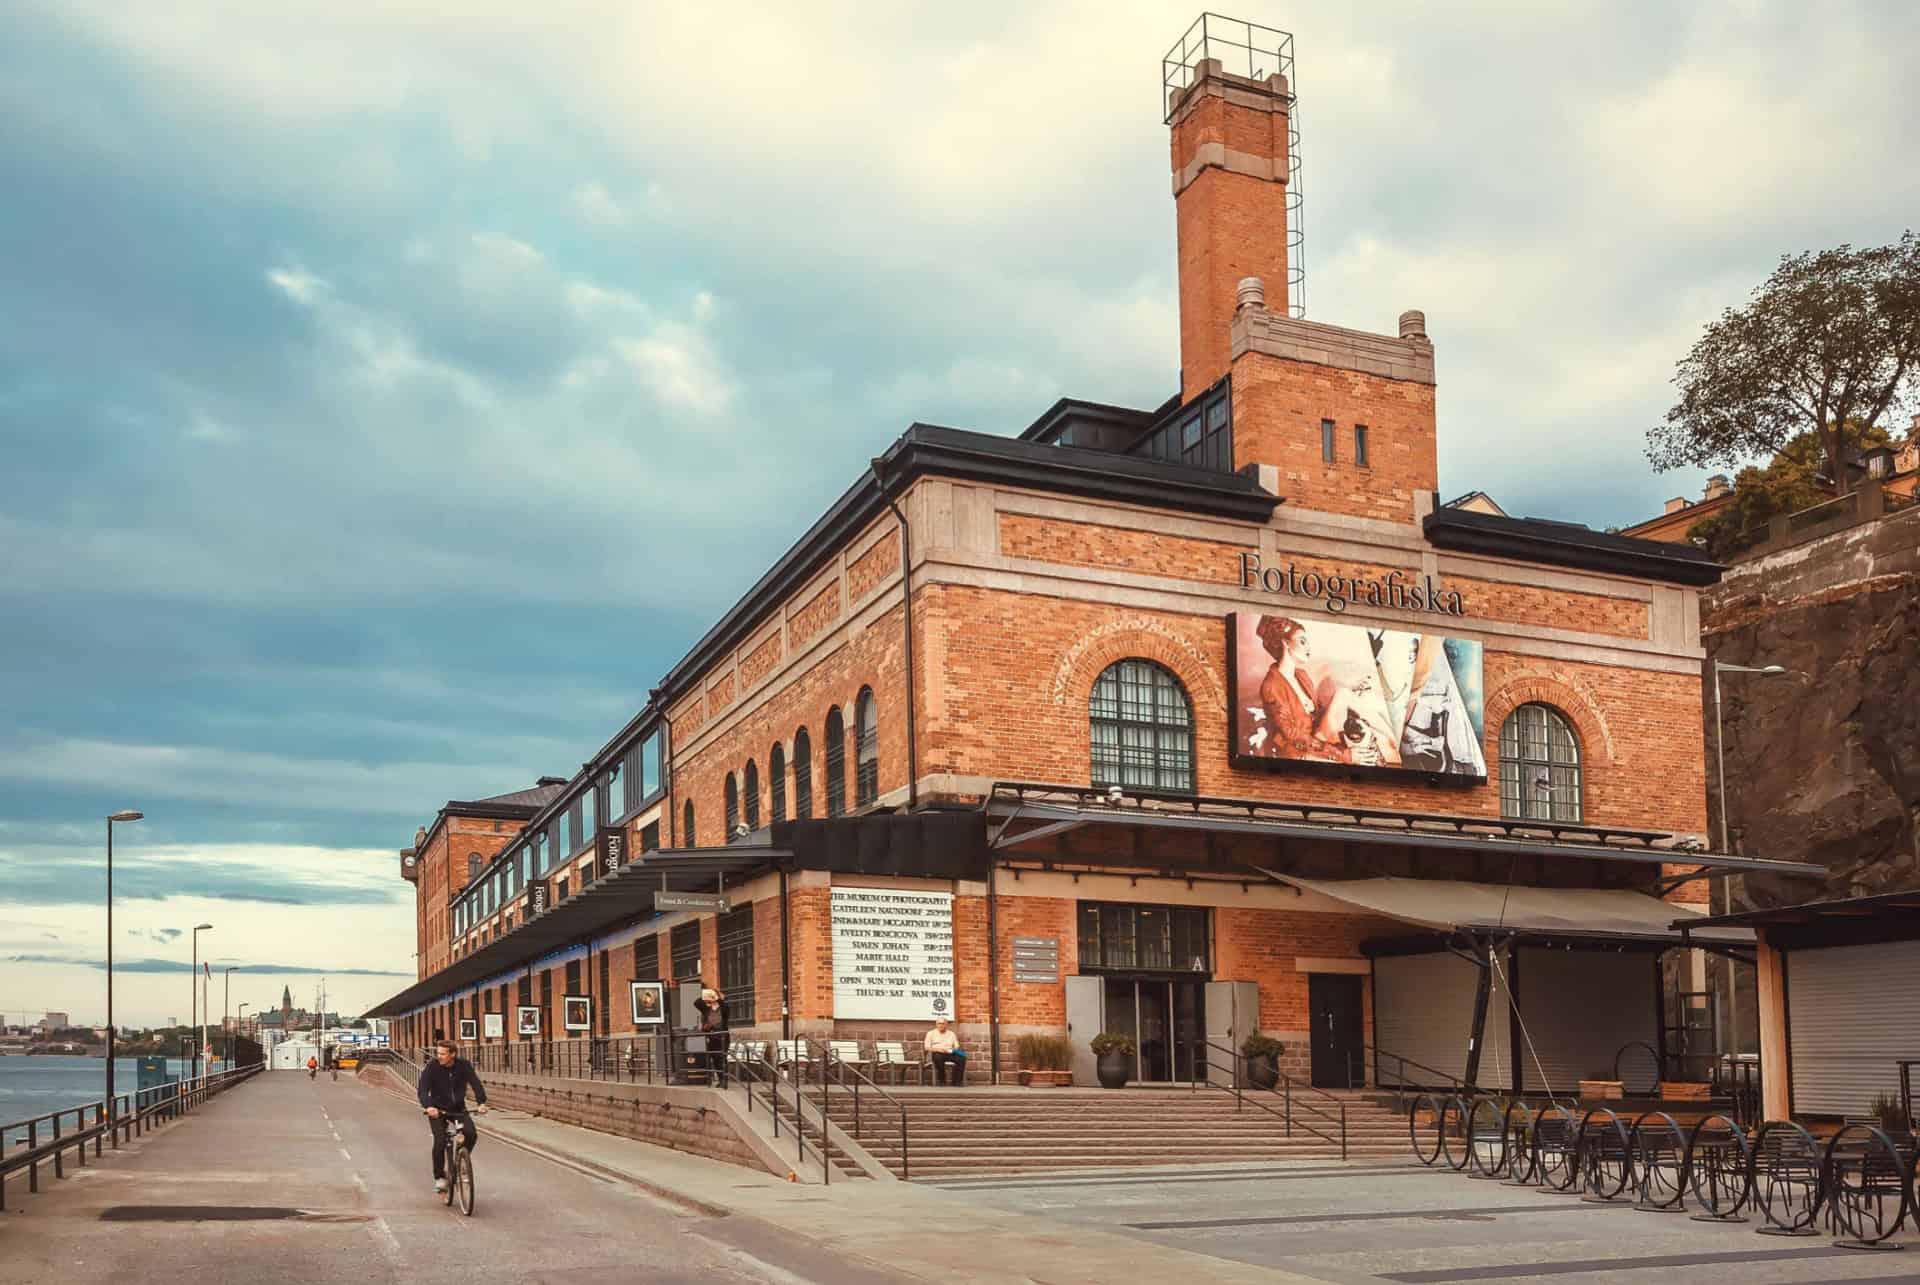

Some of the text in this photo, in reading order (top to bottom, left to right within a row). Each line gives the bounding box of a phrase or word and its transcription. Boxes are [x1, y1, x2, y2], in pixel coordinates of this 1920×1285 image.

[1237, 551, 1465, 616] Fotografiska
[832, 893, 844, 901] THE
[847, 893, 880, 902] MUSEUM
[892, 896, 948, 905] PHOTOGRAPHY
[833, 905, 876, 913] CATHLEEN
[878, 907, 922, 916] NAUNDORF
[883, 919, 930, 928] MCCARTNEY
[840, 929, 871, 937] EVELYN
[852, 941, 910, 951] SIMEN JOHAN
[885, 954, 909, 962] HALD
[1192, 956, 1203, 971] A
[878, 966, 910, 974] HASSAN
[840, 977, 861, 985] OPEN
